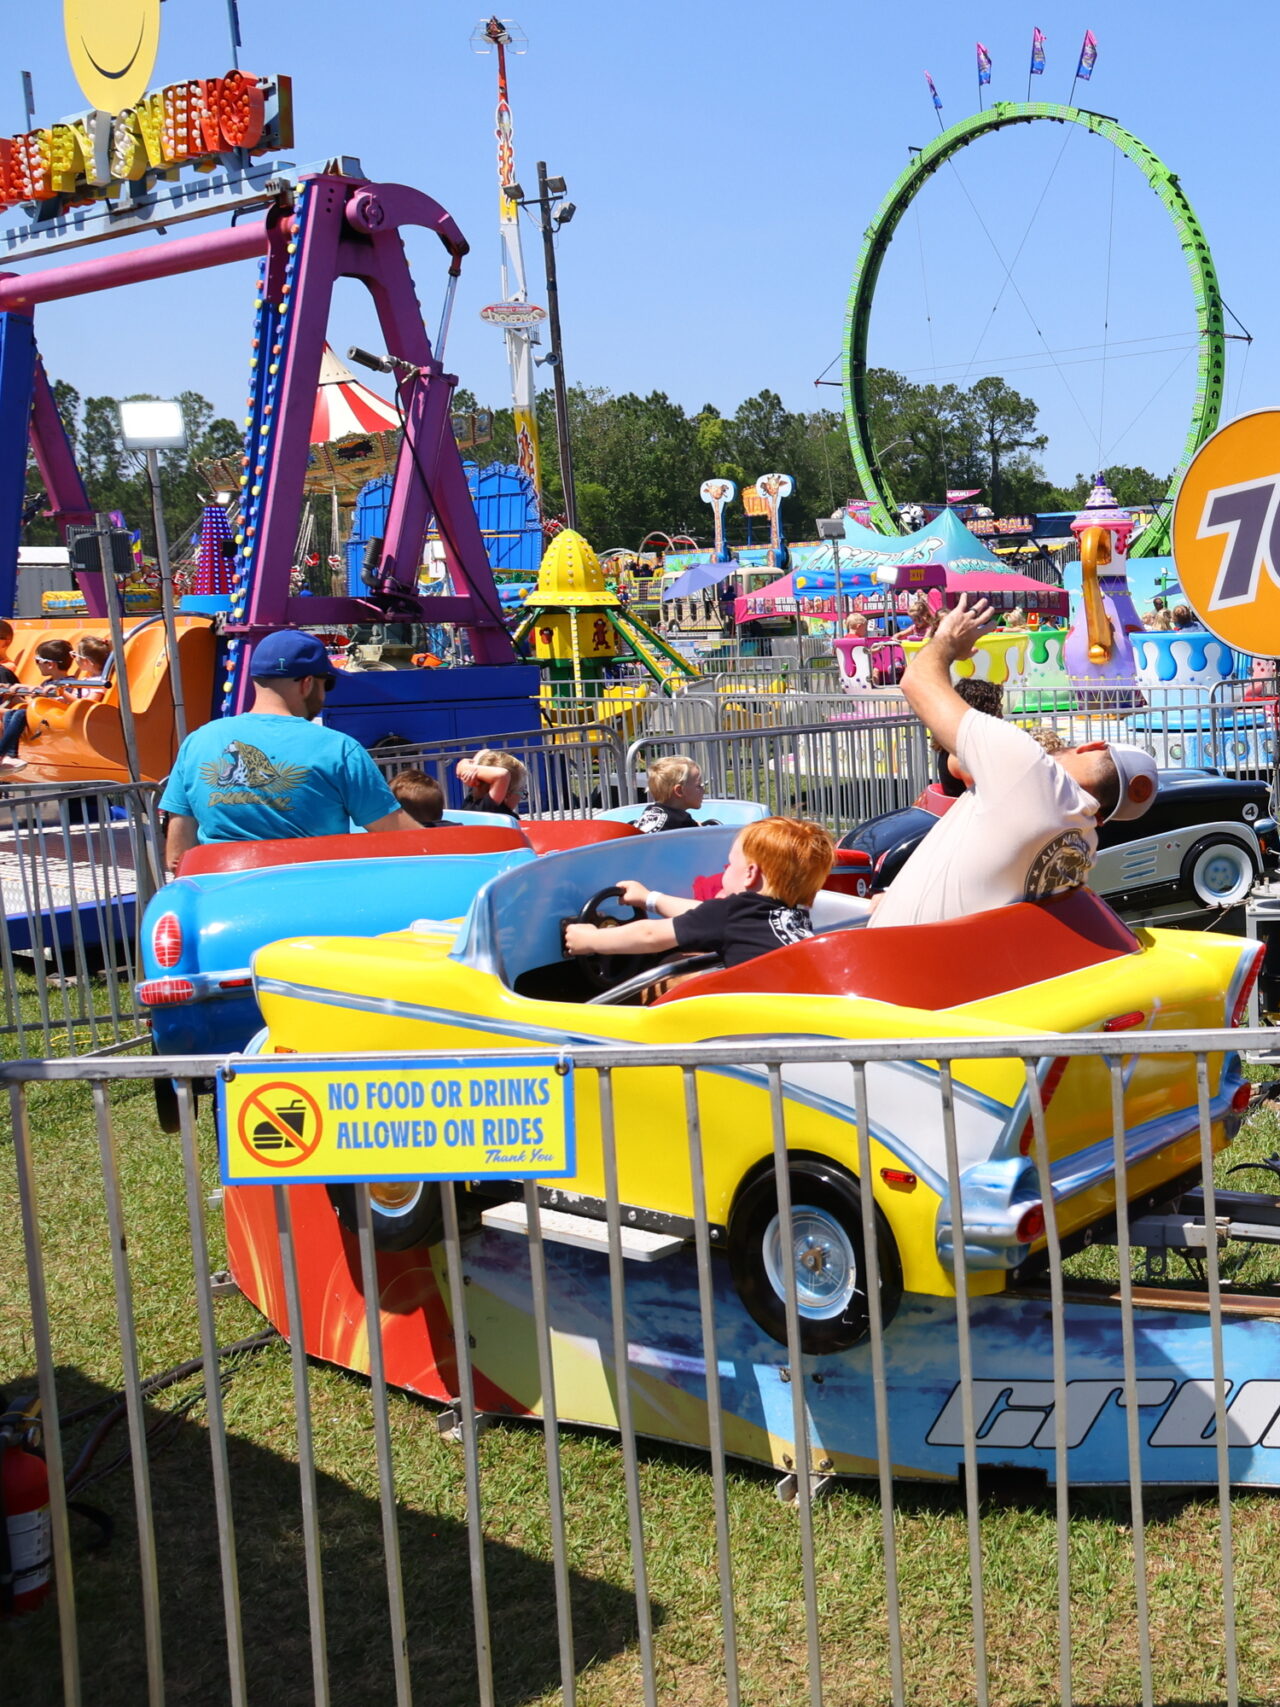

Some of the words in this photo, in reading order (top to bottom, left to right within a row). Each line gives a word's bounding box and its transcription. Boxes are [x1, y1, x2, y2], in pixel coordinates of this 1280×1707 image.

[1245, 806, 1256, 817] 4
[328, 1082, 359, 1110] NO
[366, 1081, 425, 1109] FOOD
[431, 1080, 463, 1108] OR
[470, 1077, 551, 1107] DRINKS
[336, 1120, 438, 1149] ALLOWED
[444, 1118, 475, 1147] ON
[482, 1117, 544, 1146] RIDES
[484, 1149, 526, 1164] Thank
[530, 1148, 555, 1163] You
